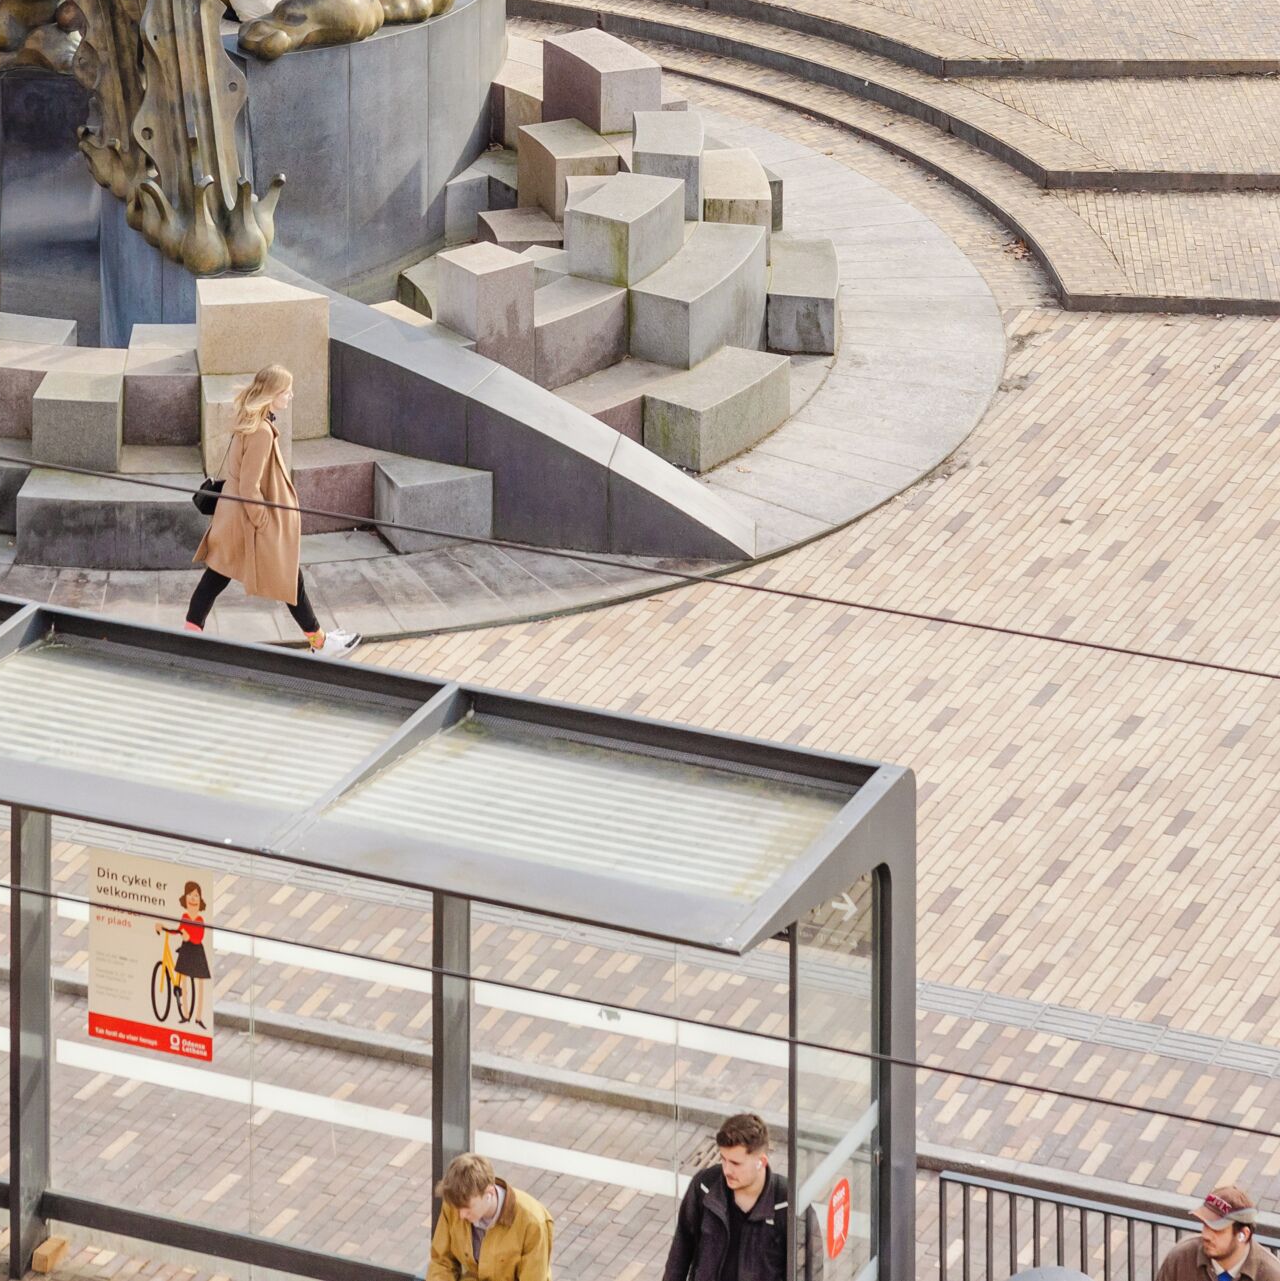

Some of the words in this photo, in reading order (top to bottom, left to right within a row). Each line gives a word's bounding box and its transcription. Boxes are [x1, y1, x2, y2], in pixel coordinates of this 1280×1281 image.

[97, 867, 118, 881] Din
[122, 874, 151, 888] cykel
[156, 881, 168, 891] er
[96, 885, 166, 907] velkommen
[108, 916, 132, 928] plads
